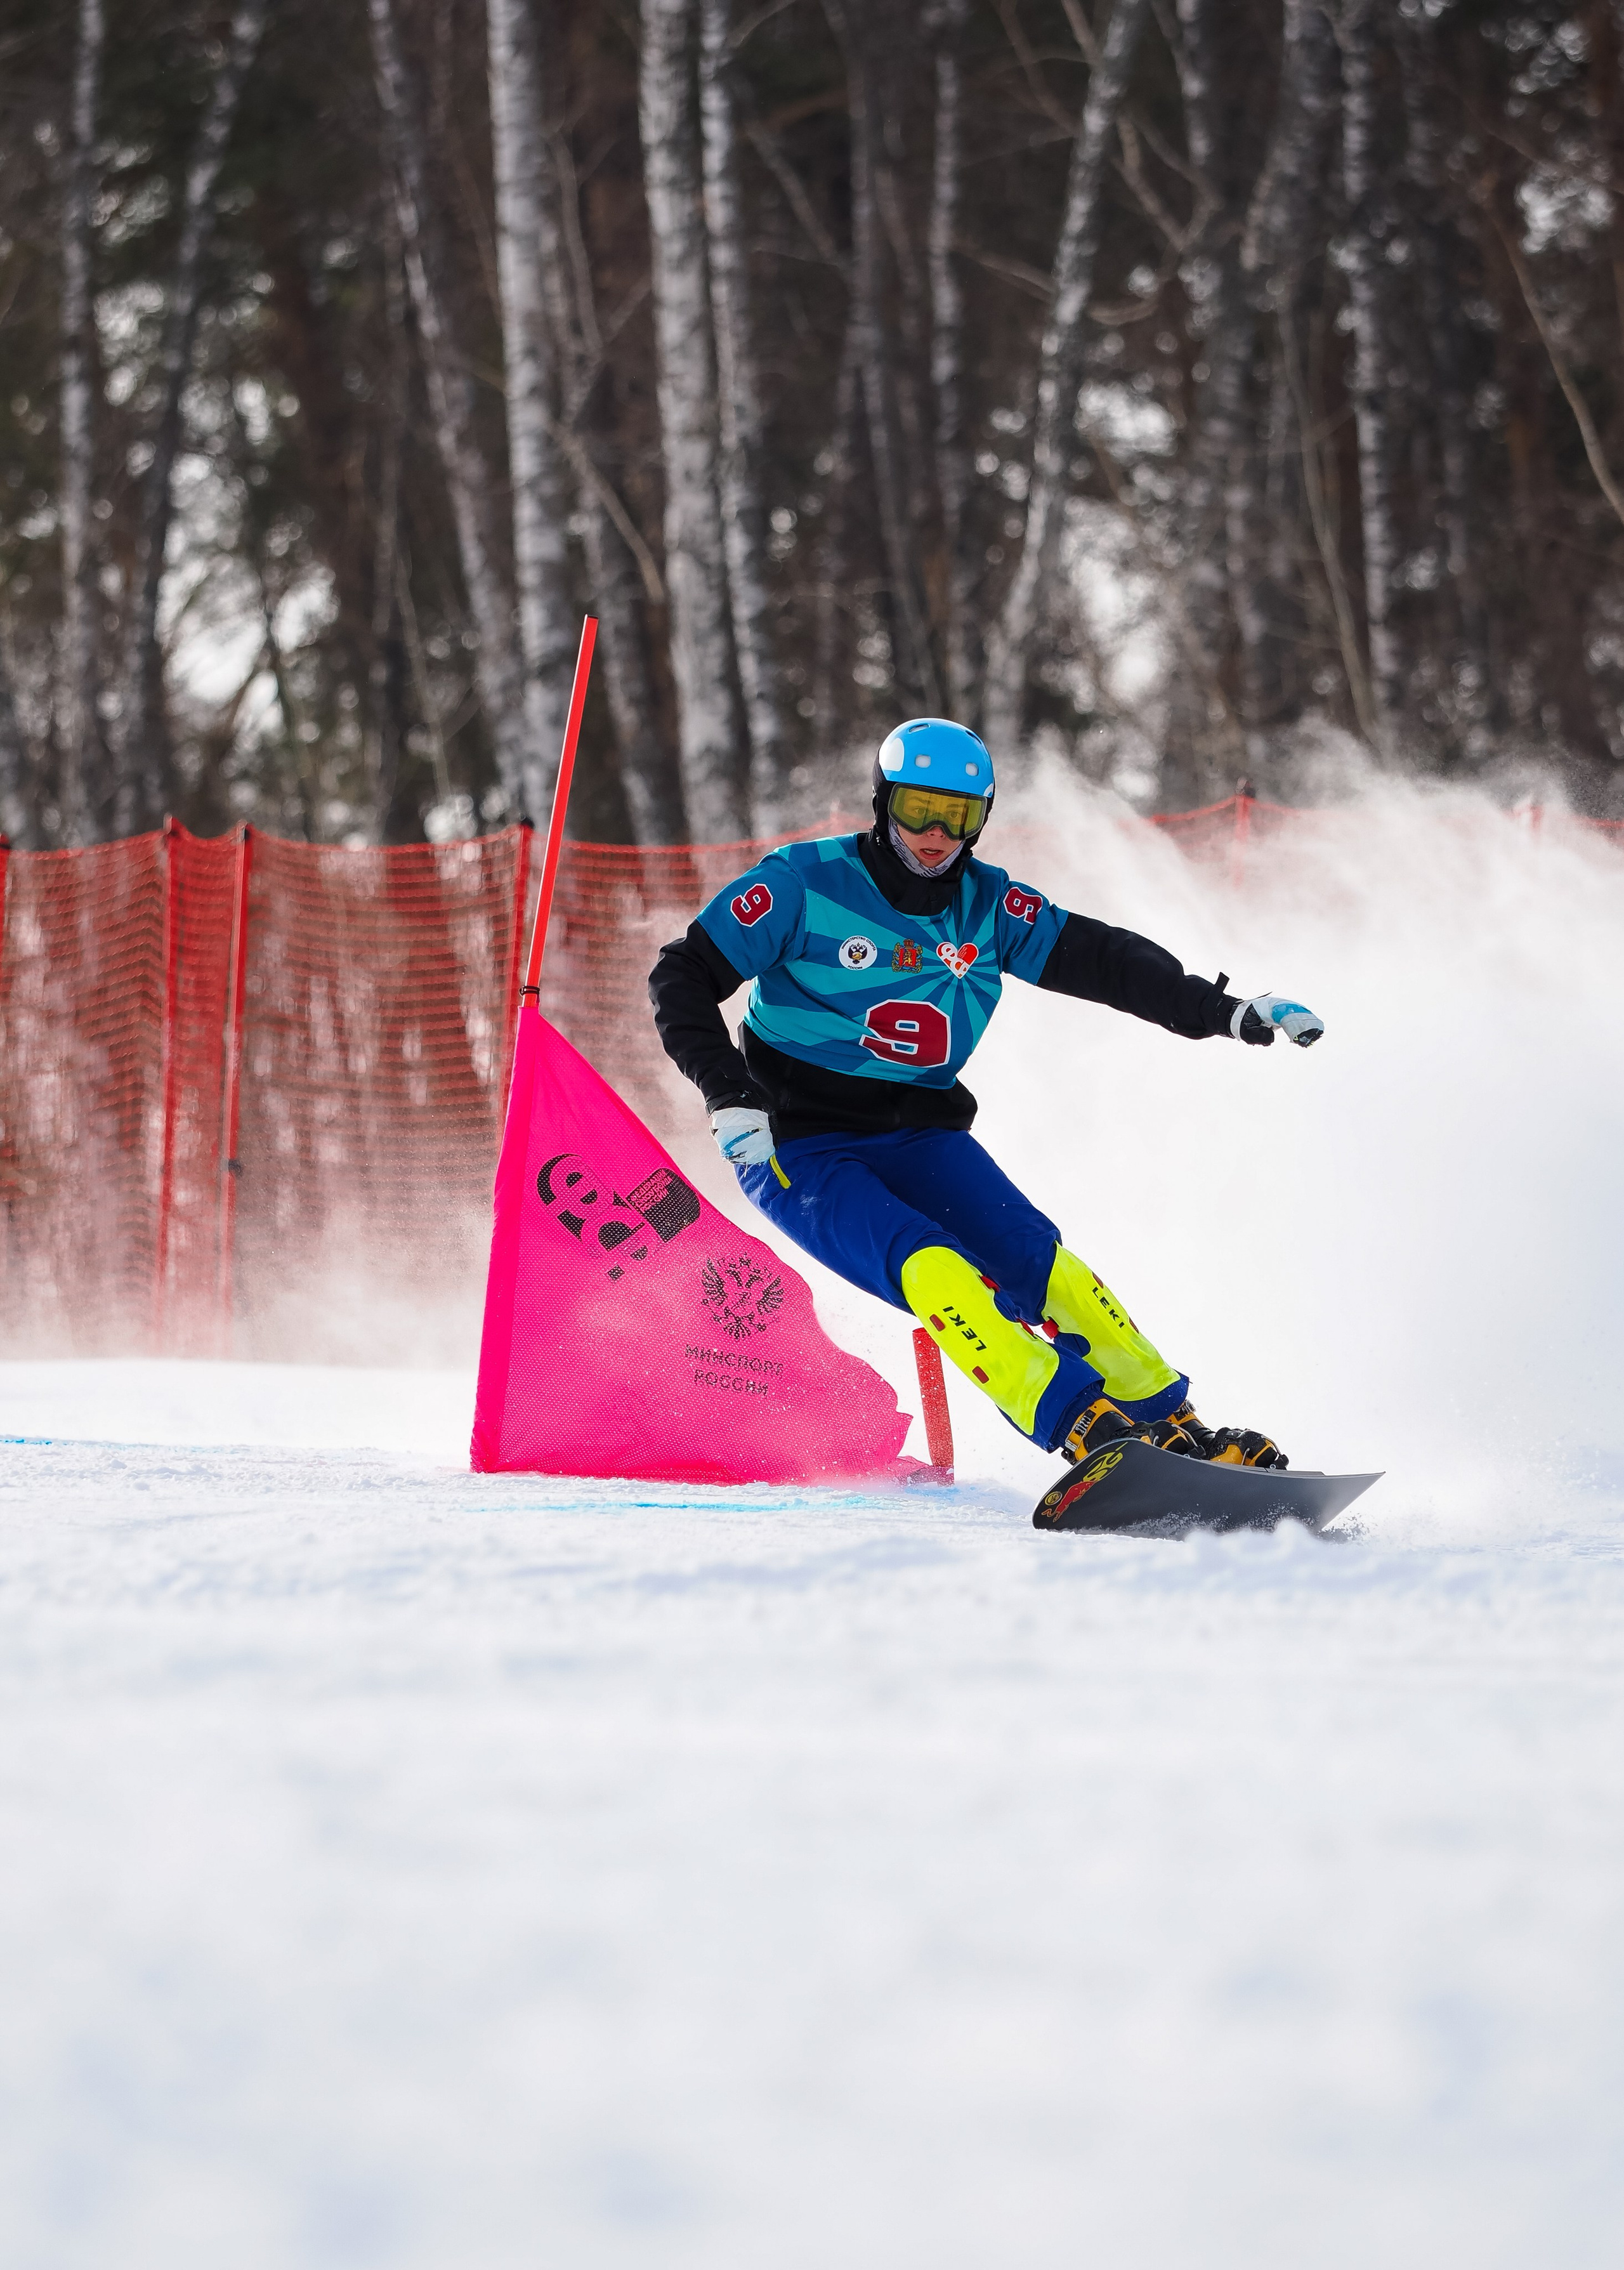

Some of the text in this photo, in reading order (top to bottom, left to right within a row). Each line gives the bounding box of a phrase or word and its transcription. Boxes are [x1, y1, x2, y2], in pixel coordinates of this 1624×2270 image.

[730, 883, 773, 927] 9
[1003, 886, 1043, 925] 9
[858, 999, 952, 1068] 9
[630, 1169, 667, 1201] ФЕДЕРАЦИЯ
[639, 1188, 669, 1213] РОССИИ
[1092, 1286, 1125, 1328] LEKI
[942, 1306, 987, 1351] LEKI
[684, 1344, 783, 1376] МИНСПОРТ
[694, 1368, 769, 1396] РОССИИ
